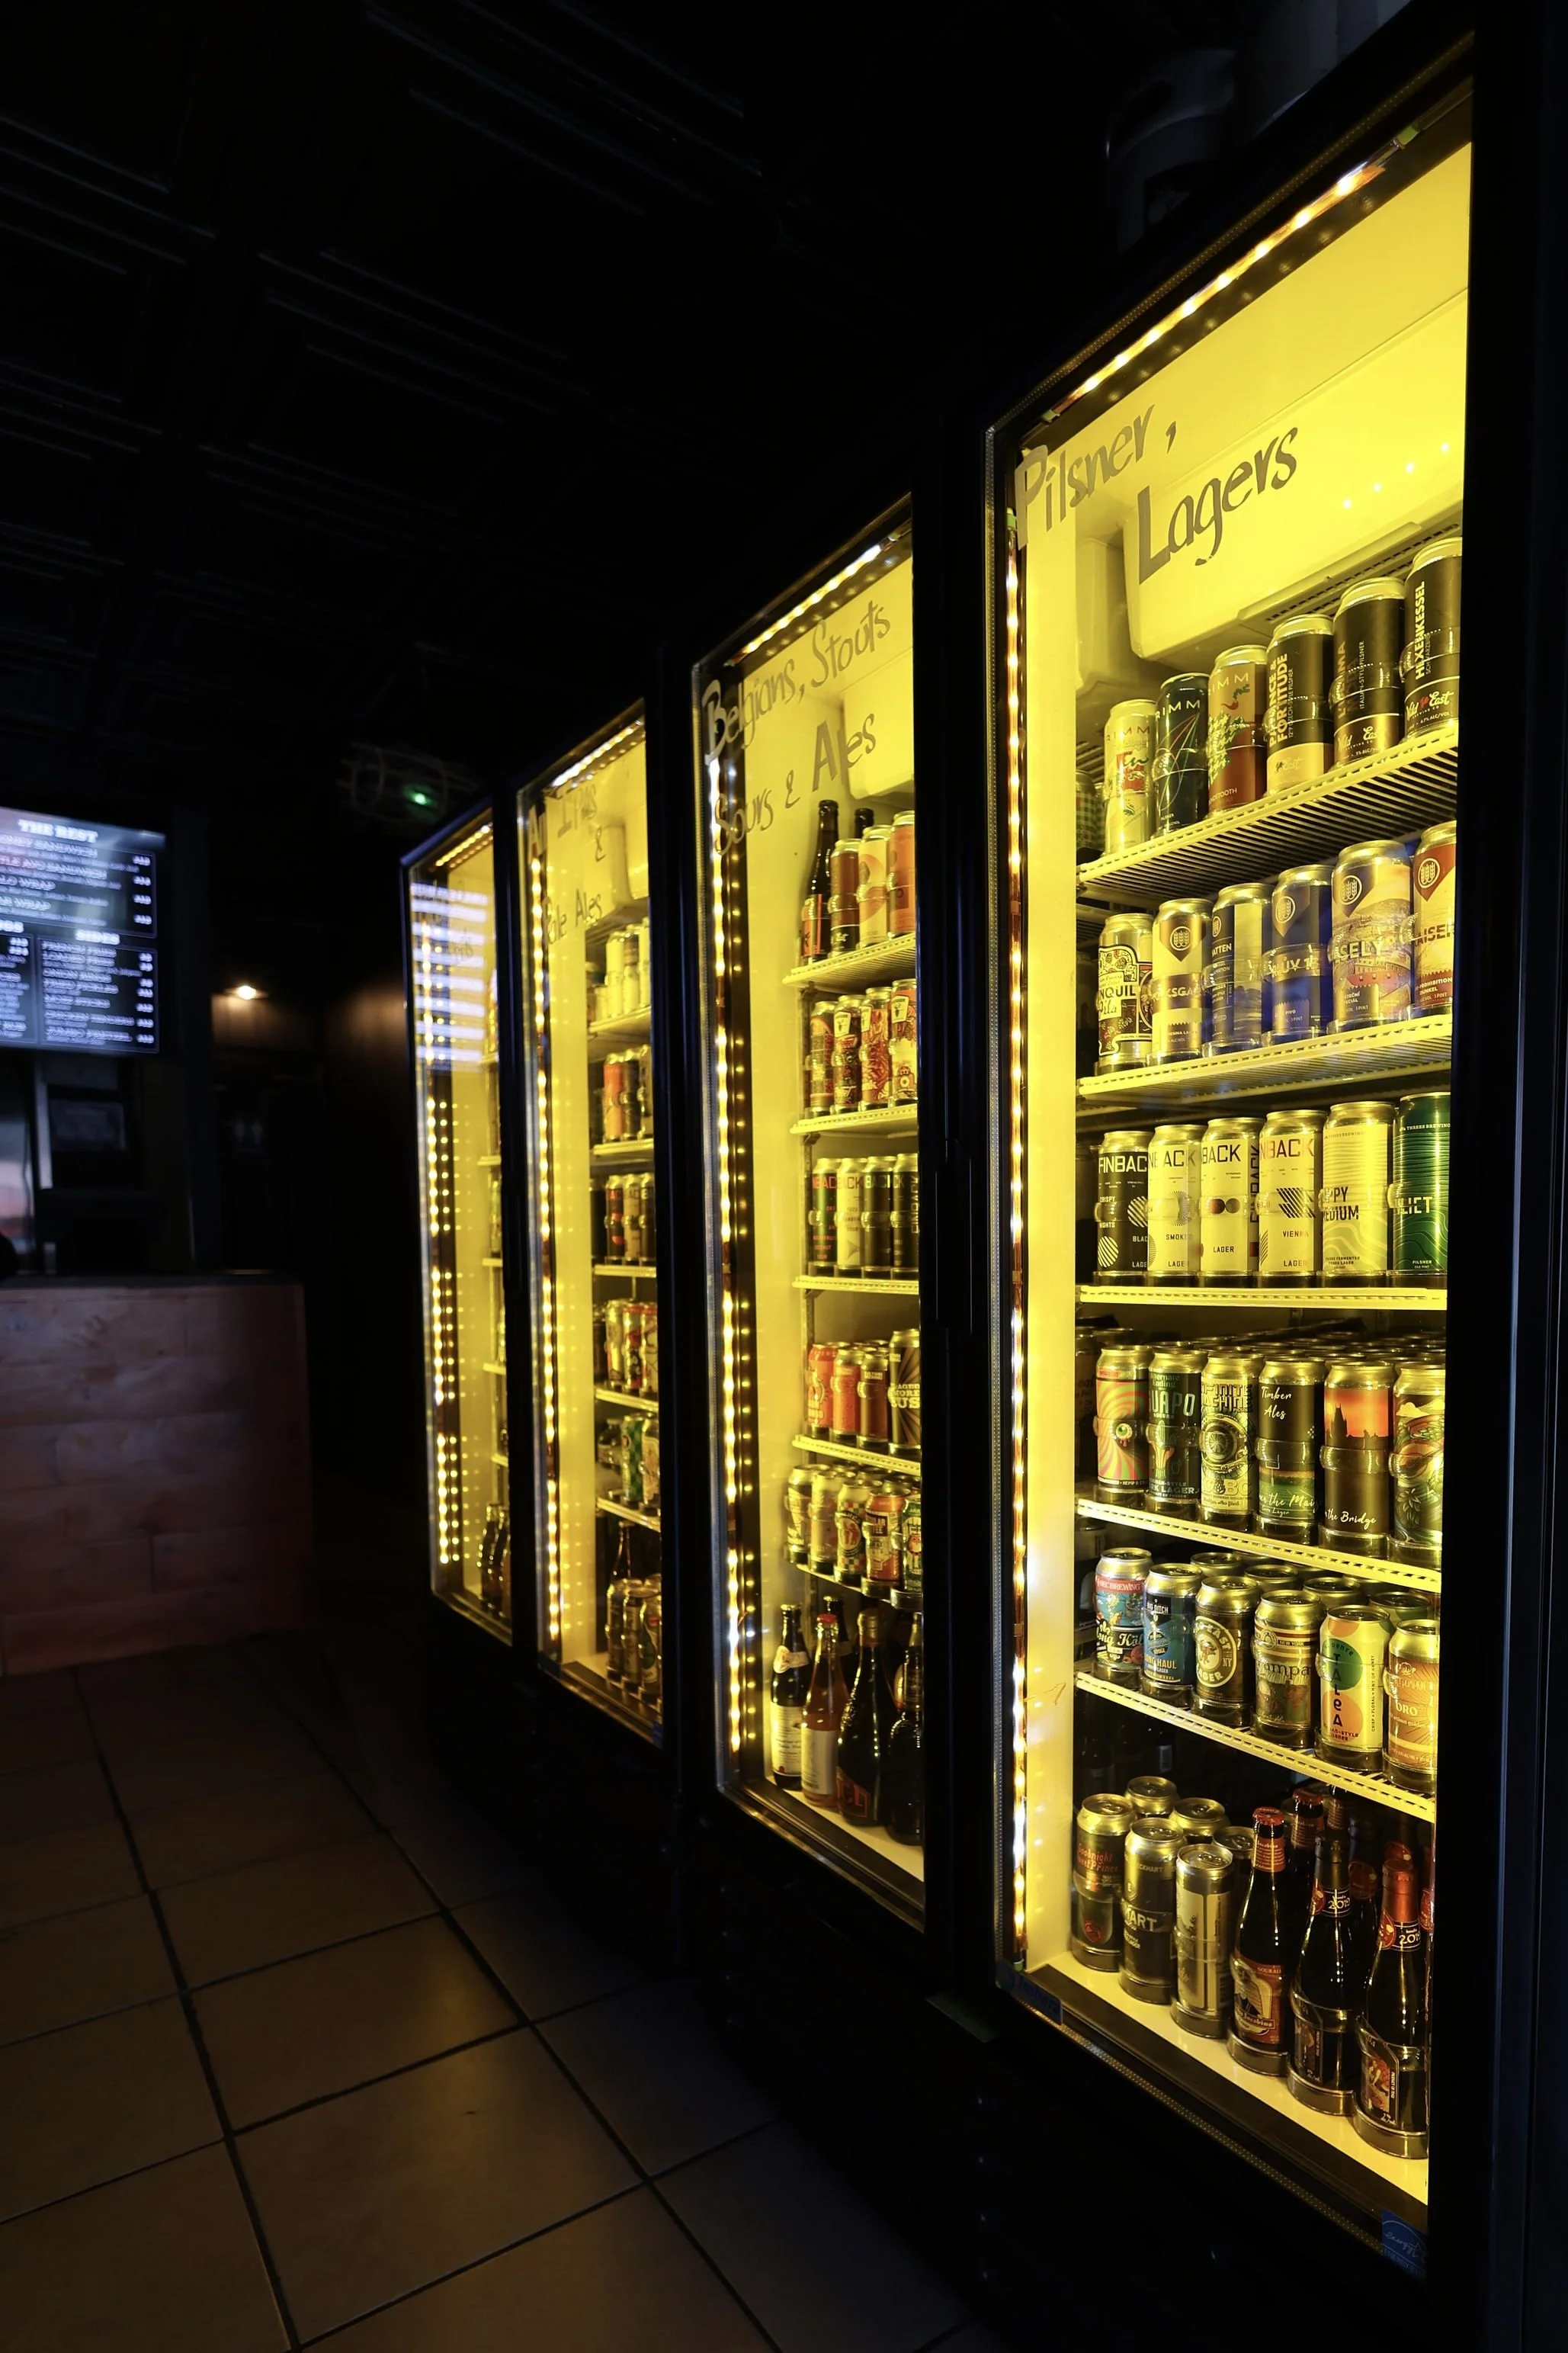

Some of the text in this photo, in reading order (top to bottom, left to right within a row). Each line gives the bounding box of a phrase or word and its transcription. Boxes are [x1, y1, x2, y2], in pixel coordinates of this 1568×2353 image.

[1138, 426, 1298, 584] Lagers
[810, 599, 891, 689] Stouts
[1429, 691, 1454, 706] East
[812, 712, 876, 792] Ales
[574, 888, 603, 928] Ales
[1261, 1386, 1291, 1400] Timber
[1264, 1404, 1286, 1420] Ales
[1340, 1510, 1377, 1530] Bridge
[1156, 1658, 1177, 1669] HAUL
[1222, 1658, 1232, 1668] NY
